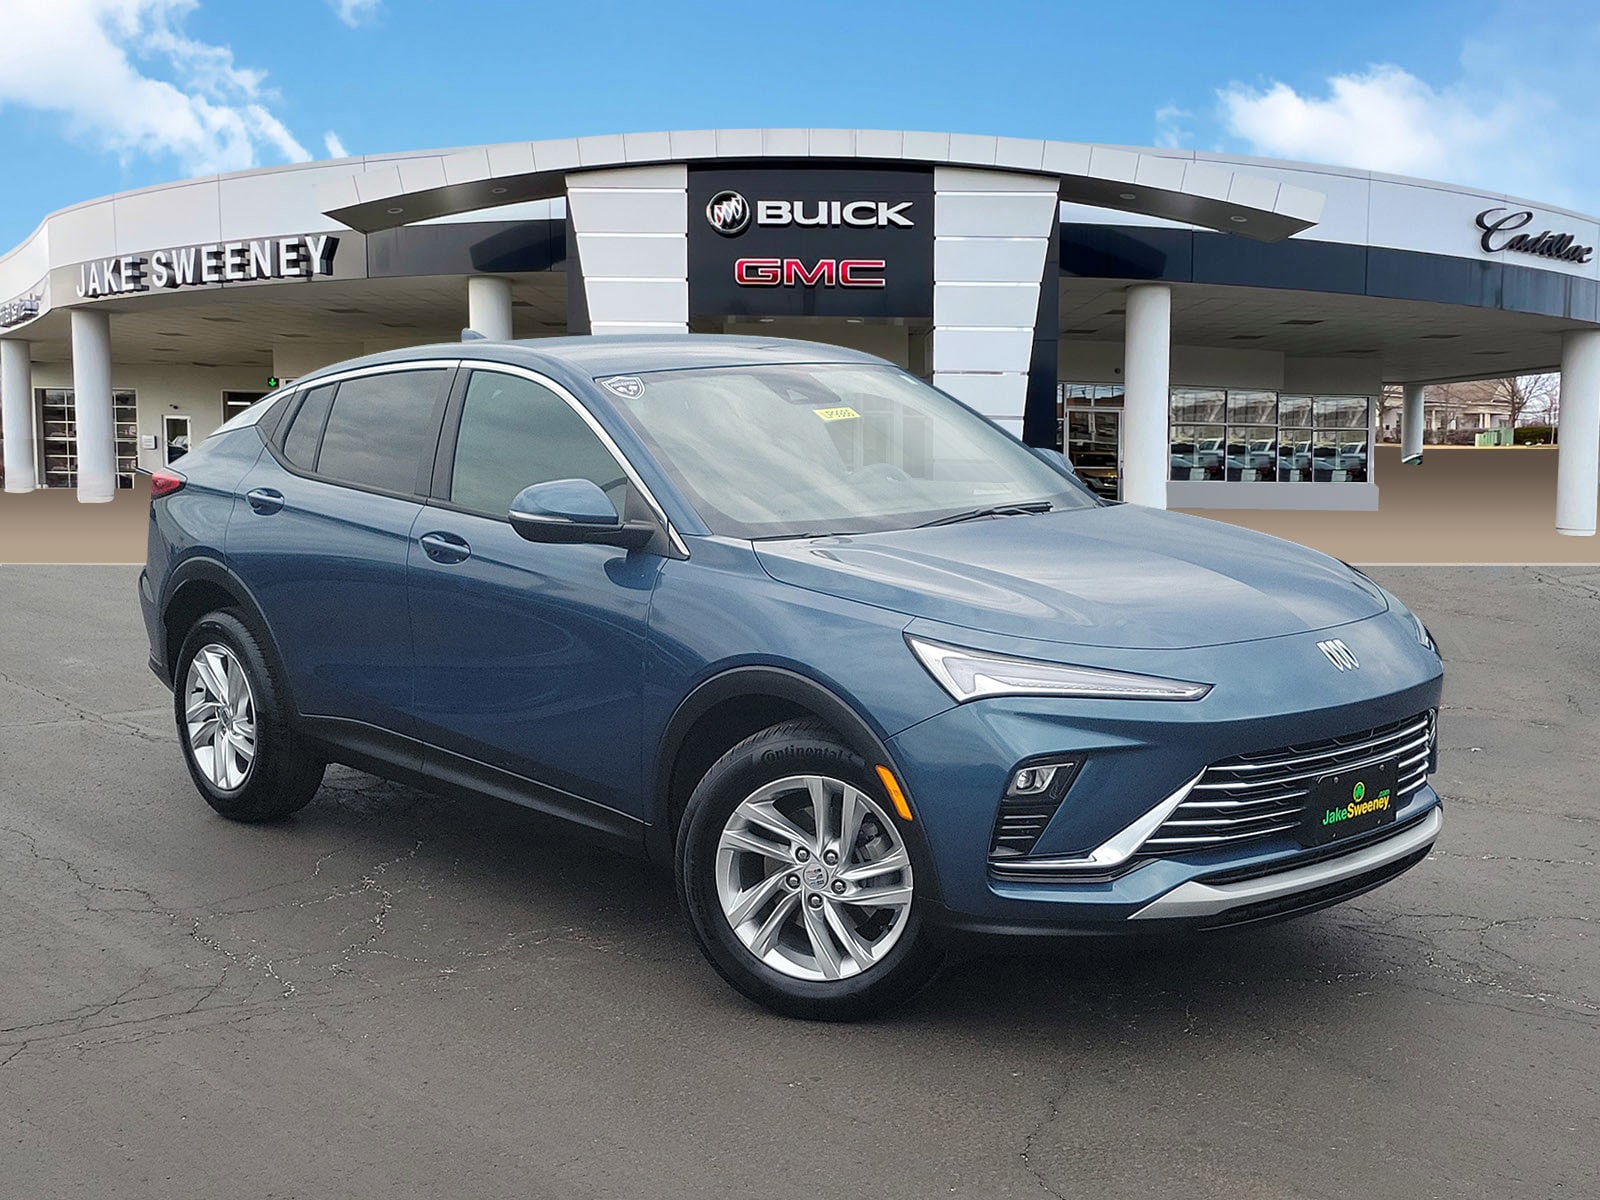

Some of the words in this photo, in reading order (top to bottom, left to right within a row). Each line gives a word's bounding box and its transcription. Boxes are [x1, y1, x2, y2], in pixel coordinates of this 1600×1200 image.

[757, 200, 915, 226] BUICK
[1475, 207, 1593, 264] Cadillac
[76, 256, 142, 298] JAKE
[151, 234, 334, 288] SWEENEY
[734, 258, 886, 287] GMC
[761, 745, 844, 761] Continental
